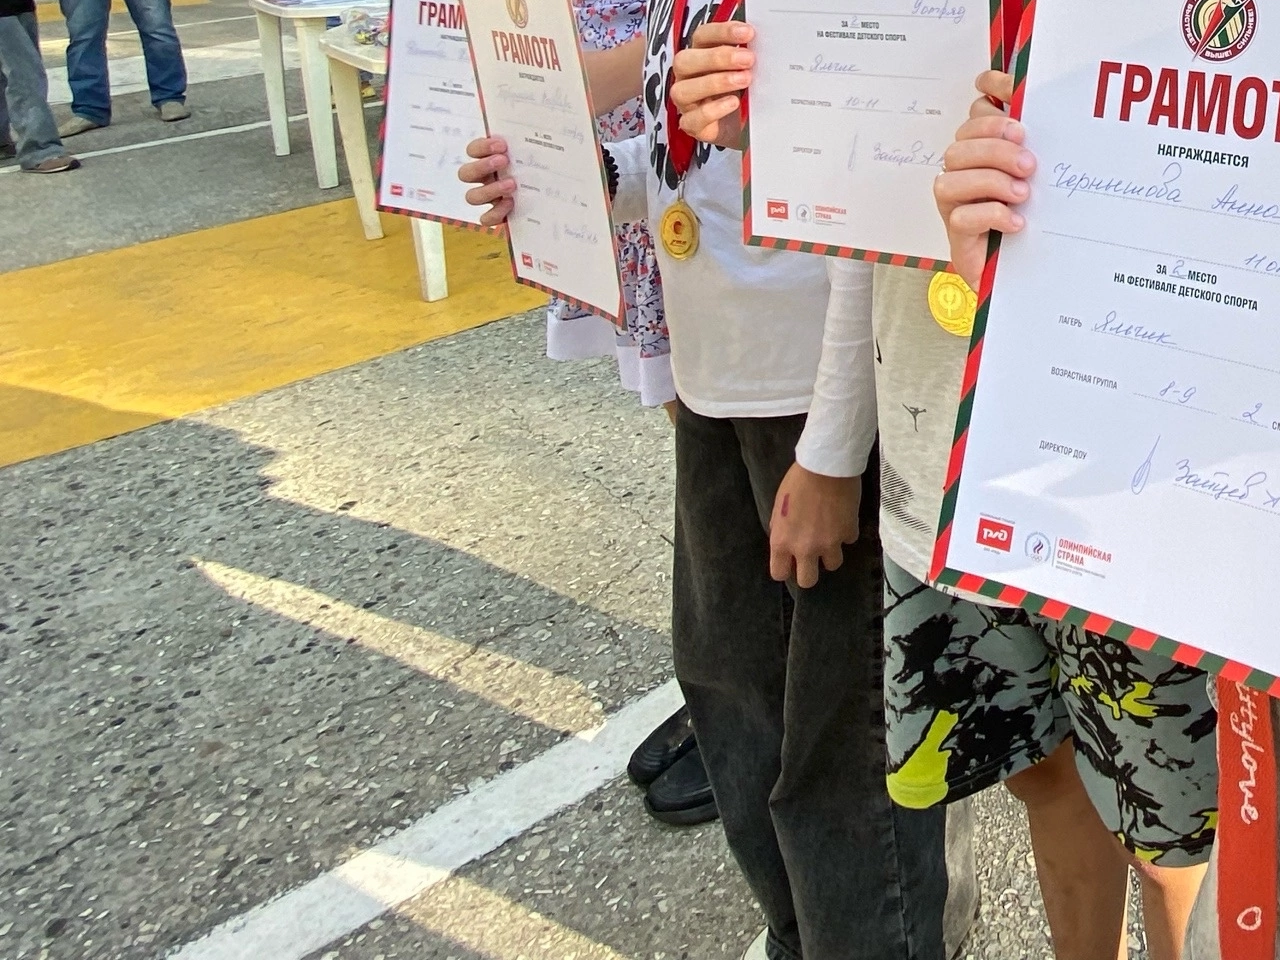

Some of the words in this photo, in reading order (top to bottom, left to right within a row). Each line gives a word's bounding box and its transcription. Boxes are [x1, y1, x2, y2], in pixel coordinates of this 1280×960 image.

[861, 21, 880, 29] МЕСТО
[825, 31, 856, 39] ФЕСТИВАЛЕ
[857, 33, 884, 41] ДЕТСКОГО
[885, 34, 907, 42] СПОРТА
[492, 30, 562, 72] ГРАМОТА
[1158, 143, 1249, 168] НАГРАЖДАЕТСЯ
[1156, 263, 1167, 275] ЗА
[1171, 259, 1185, 276] 2
[1187, 270, 1217, 285] МЕСТО
[1113, 272, 1125, 285] НА
[1127, 275, 1177, 295] ФЕСТИВАЛЕ
[1178, 286, 1222, 303] ДЕТСКОГО
[1223, 294, 1258, 311] СПОРТА
[1058, 315, 1082, 328] ЛАГЕРЬ
[1050, 366, 1092, 384] ВОЗРАСТНАЯ
[1093, 376, 1117, 389] ГРУППА
[1242, 402, 1263, 424] 2
[1039, 440, 1073, 456] ДИРЕКТОР
[1072, 449, 1087, 460] ДОУ
[1057, 550, 1084, 566] СТРАНА
[1058, 538, 1112, 563] ОЛИМПИЙСКАЯ
